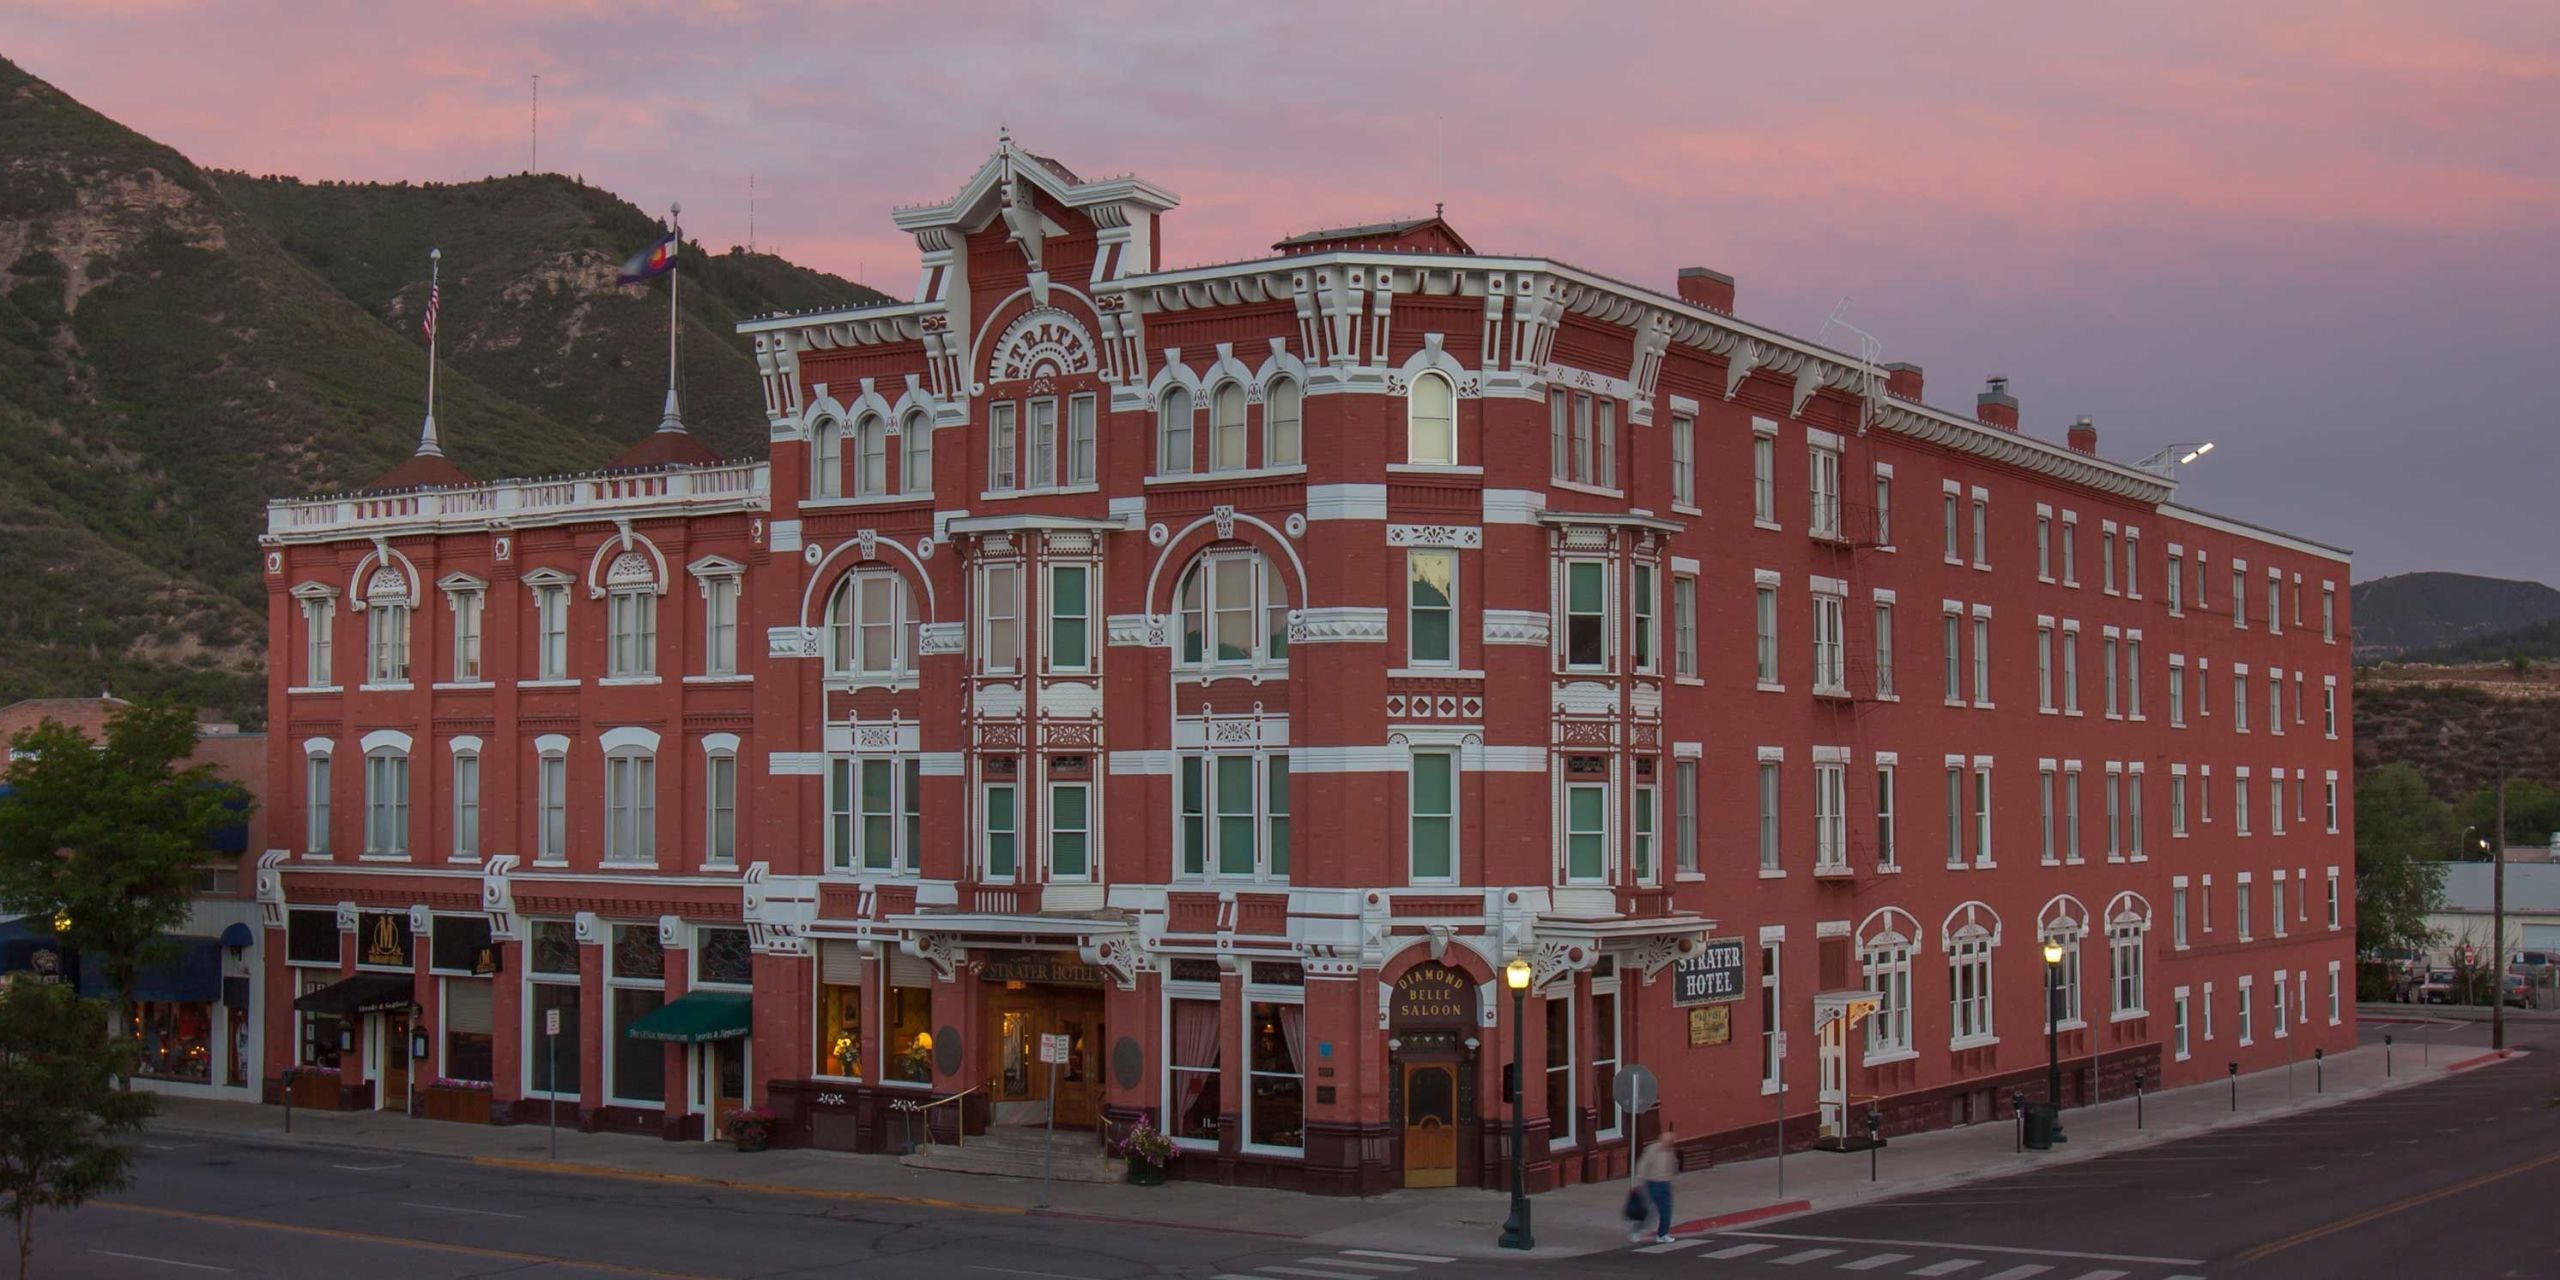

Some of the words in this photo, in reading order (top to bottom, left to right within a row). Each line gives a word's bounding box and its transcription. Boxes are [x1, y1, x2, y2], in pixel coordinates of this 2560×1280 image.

[1004, 323, 1088, 379] STRATER
[989, 963, 1048, 981] STRATER
[1051, 965, 1097, 982] HOTEL
[1399, 969, 1464, 990] DIAMOND
[1686, 971, 1733, 996] HOTEL
[1410, 989, 1451, 1001] BELLE
[1401, 1005, 1461, 1016] SALOON
